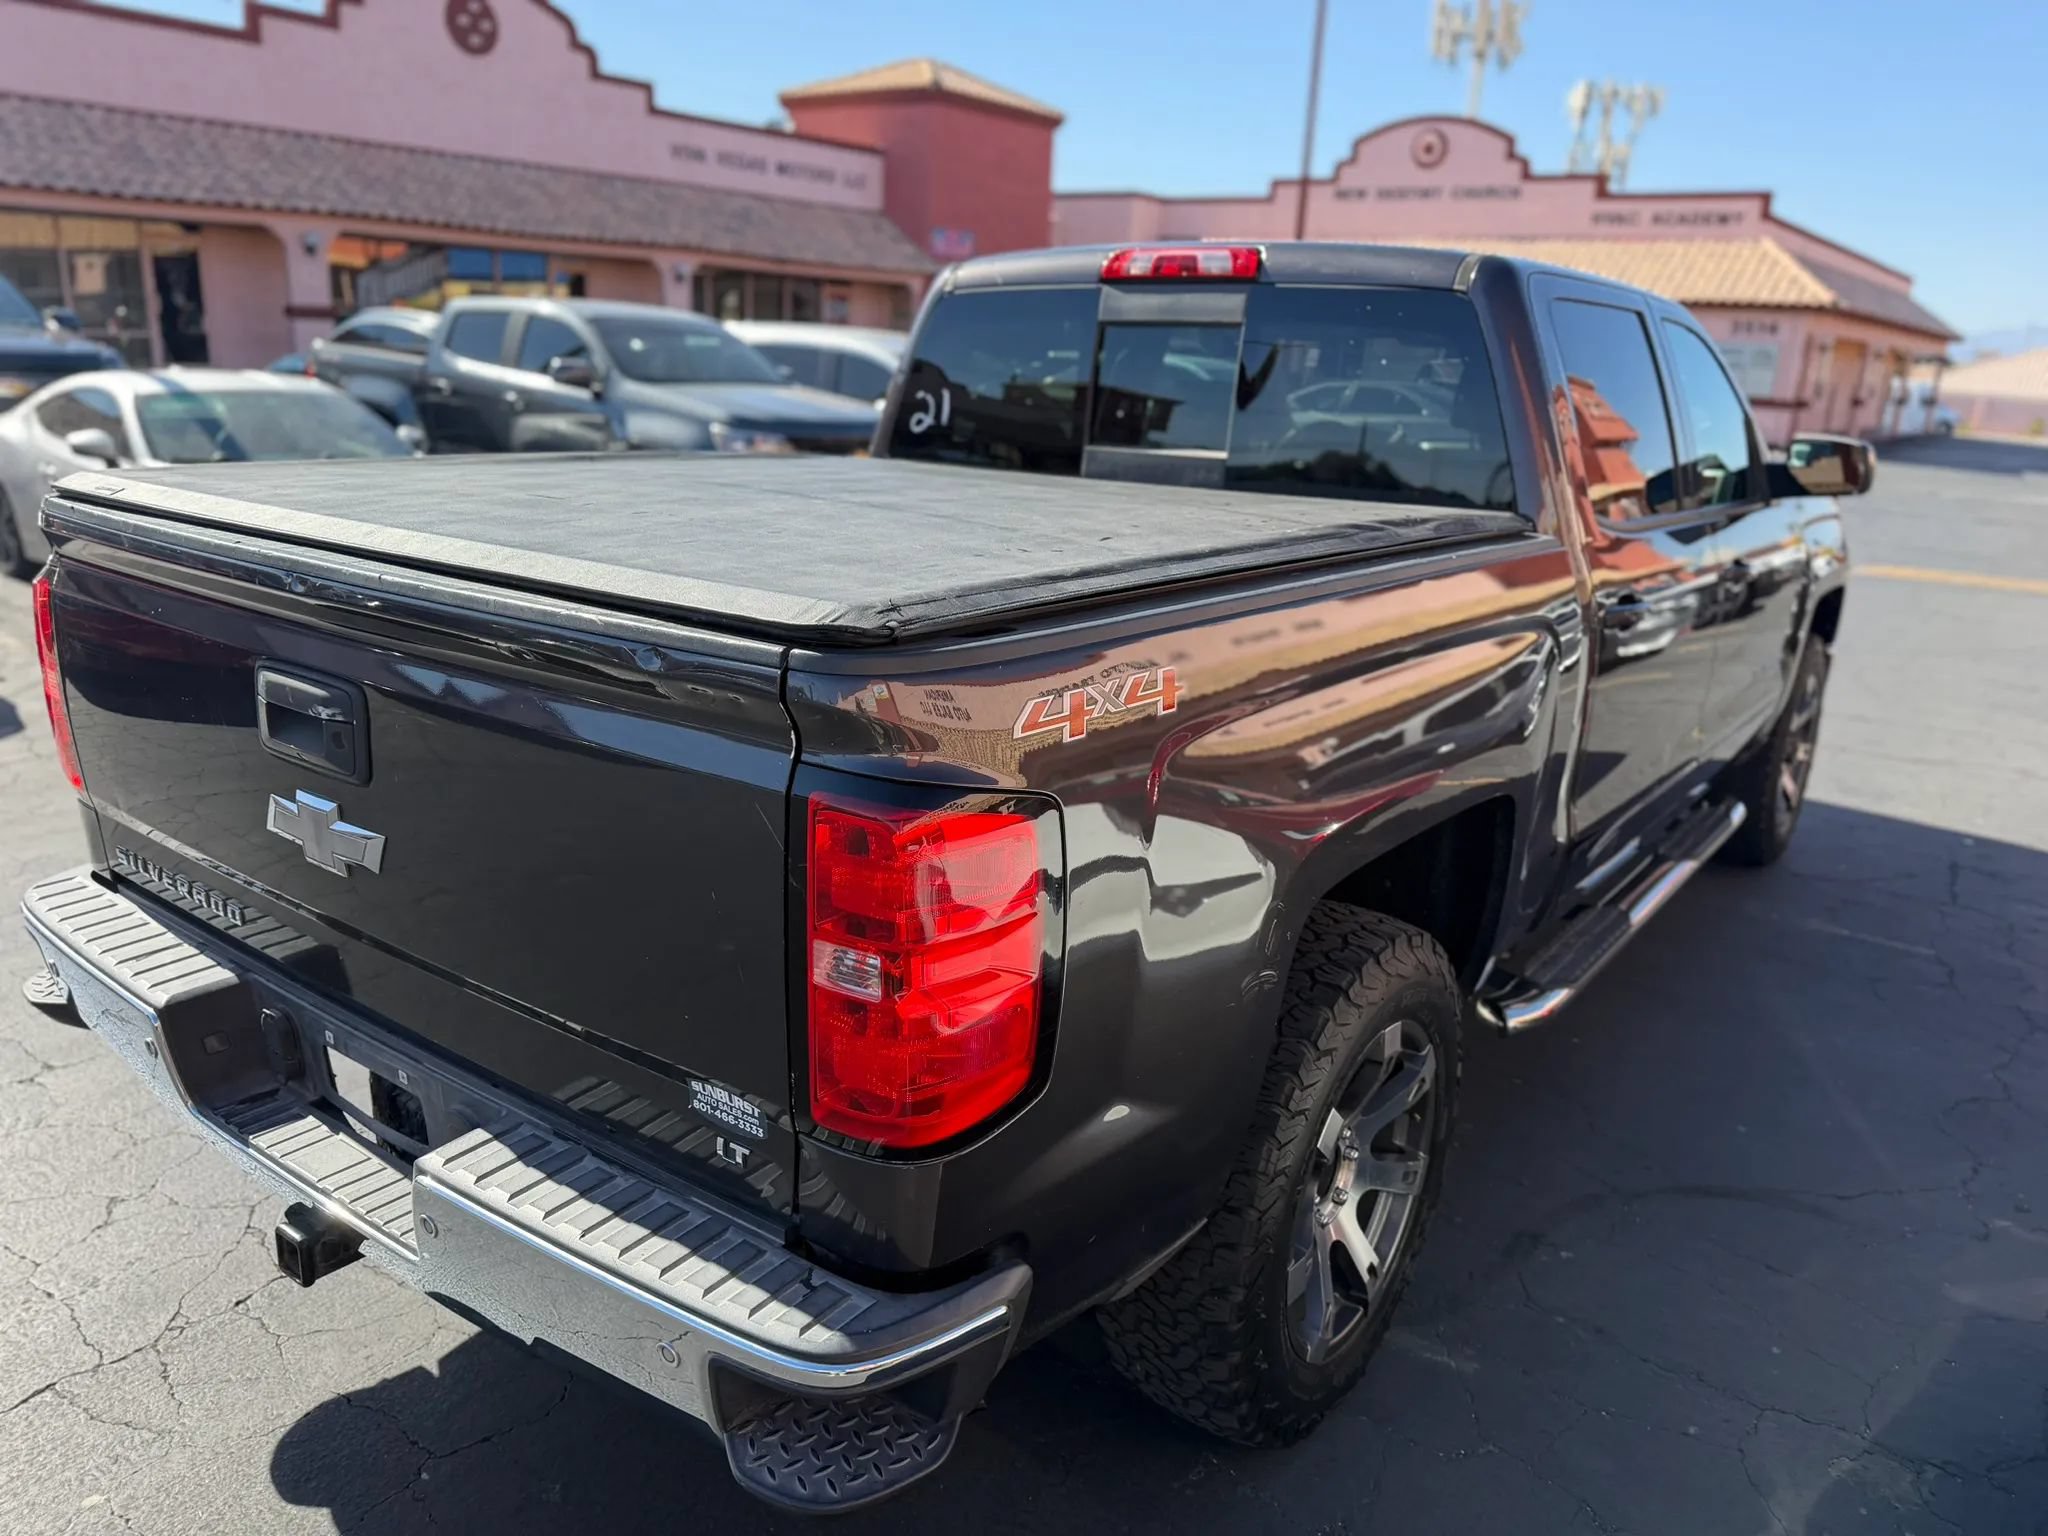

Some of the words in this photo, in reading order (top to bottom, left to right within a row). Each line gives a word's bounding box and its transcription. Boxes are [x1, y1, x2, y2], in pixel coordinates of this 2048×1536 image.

[1651, 210, 1743, 227] ACADEMY
[909, 388, 951, 434] 21
[116, 844, 244, 927] SILVERADO
[691, 1080, 761, 1118] SUNBURST
[697, 1093, 717, 1108] AUTO
[693, 1099, 764, 1138] 801-466-3333
[717, 1136, 750, 1168] LT
